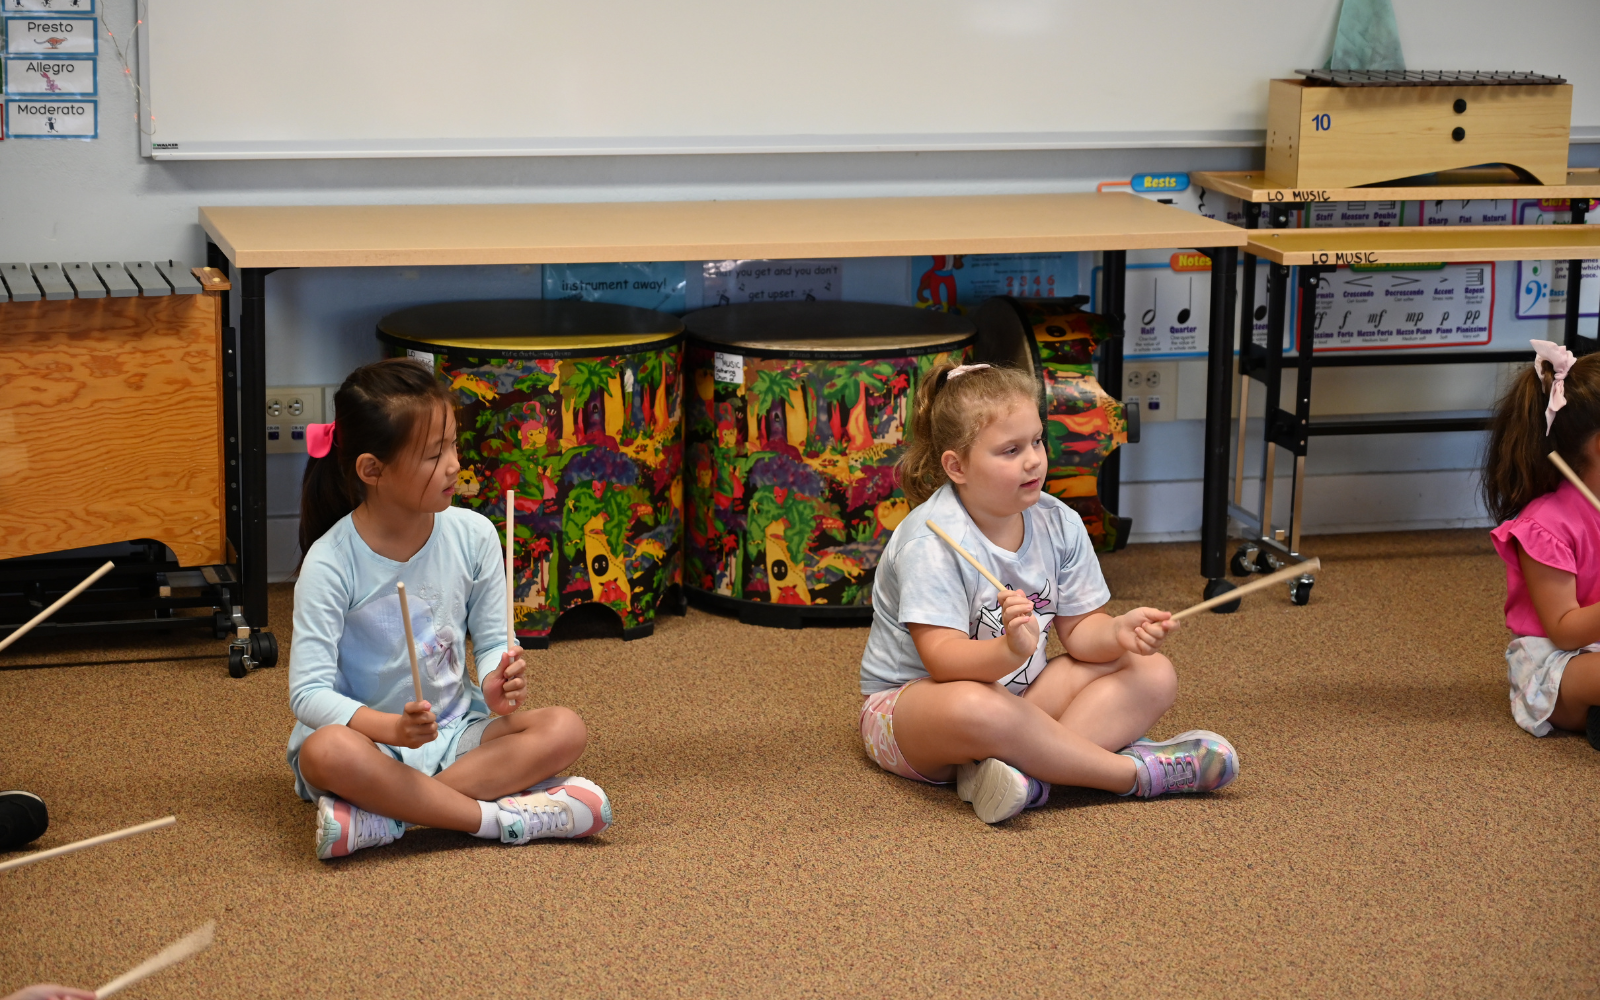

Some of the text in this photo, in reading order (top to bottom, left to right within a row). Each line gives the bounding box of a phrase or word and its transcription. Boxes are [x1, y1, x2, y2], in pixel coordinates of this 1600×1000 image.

[27, 22, 74, 33] Presto
[26, 62, 75, 75] Allegro
[17, 104, 85, 115] Moderato
[1311, 113, 1331, 131] 10
[1144, 176, 1177, 188] Rests
[1267, 190, 1331, 202] LO MUSIC
[1316, 213, 1333, 221] Staff
[1341, 212, 1370, 220] Measure
[1373, 211, 1397, 220] Double
[1458, 215, 1472, 223] Flat
[1482, 214, 1507, 223] Natural
[1428, 217, 1449, 226] Sharp
[1178, 255, 1212, 267] Notes
[1312, 252, 1379, 264] LO MUSIC
[736, 269, 752, 279] you
[754, 267, 771, 279] get
[774, 266, 792, 275] and
[794, 268, 811, 278] you
[814, 265, 838, 275] don't
[1554, 266, 1564, 274] go
[562, 278, 667, 293] instrument away!
[1006, 276, 1014, 287] 2
[1019, 275, 1027, 287] 3
[1033, 275, 1041, 286] 4
[1047, 274, 1055, 286] 6
[748, 289, 797, 302] get upset.
[1343, 290, 1374, 298] Crescendo
[1385, 289, 1424, 297] Decrescendo
[1464, 287, 1485, 295] Repeat
[1549, 289, 1564, 297] Bass
[1338, 310, 1352, 330] f
[1367, 309, 1387, 329] mf
[1405, 311, 1424, 327] mp
[1439, 311, 1450, 326] p
[1463, 310, 1481, 325] pp
[1141, 327, 1155, 335] Half
[1169, 326, 1197, 334] Quarter
[1396, 328, 1414, 336] Mezzo
[722, 359, 741, 369] MUSIC
